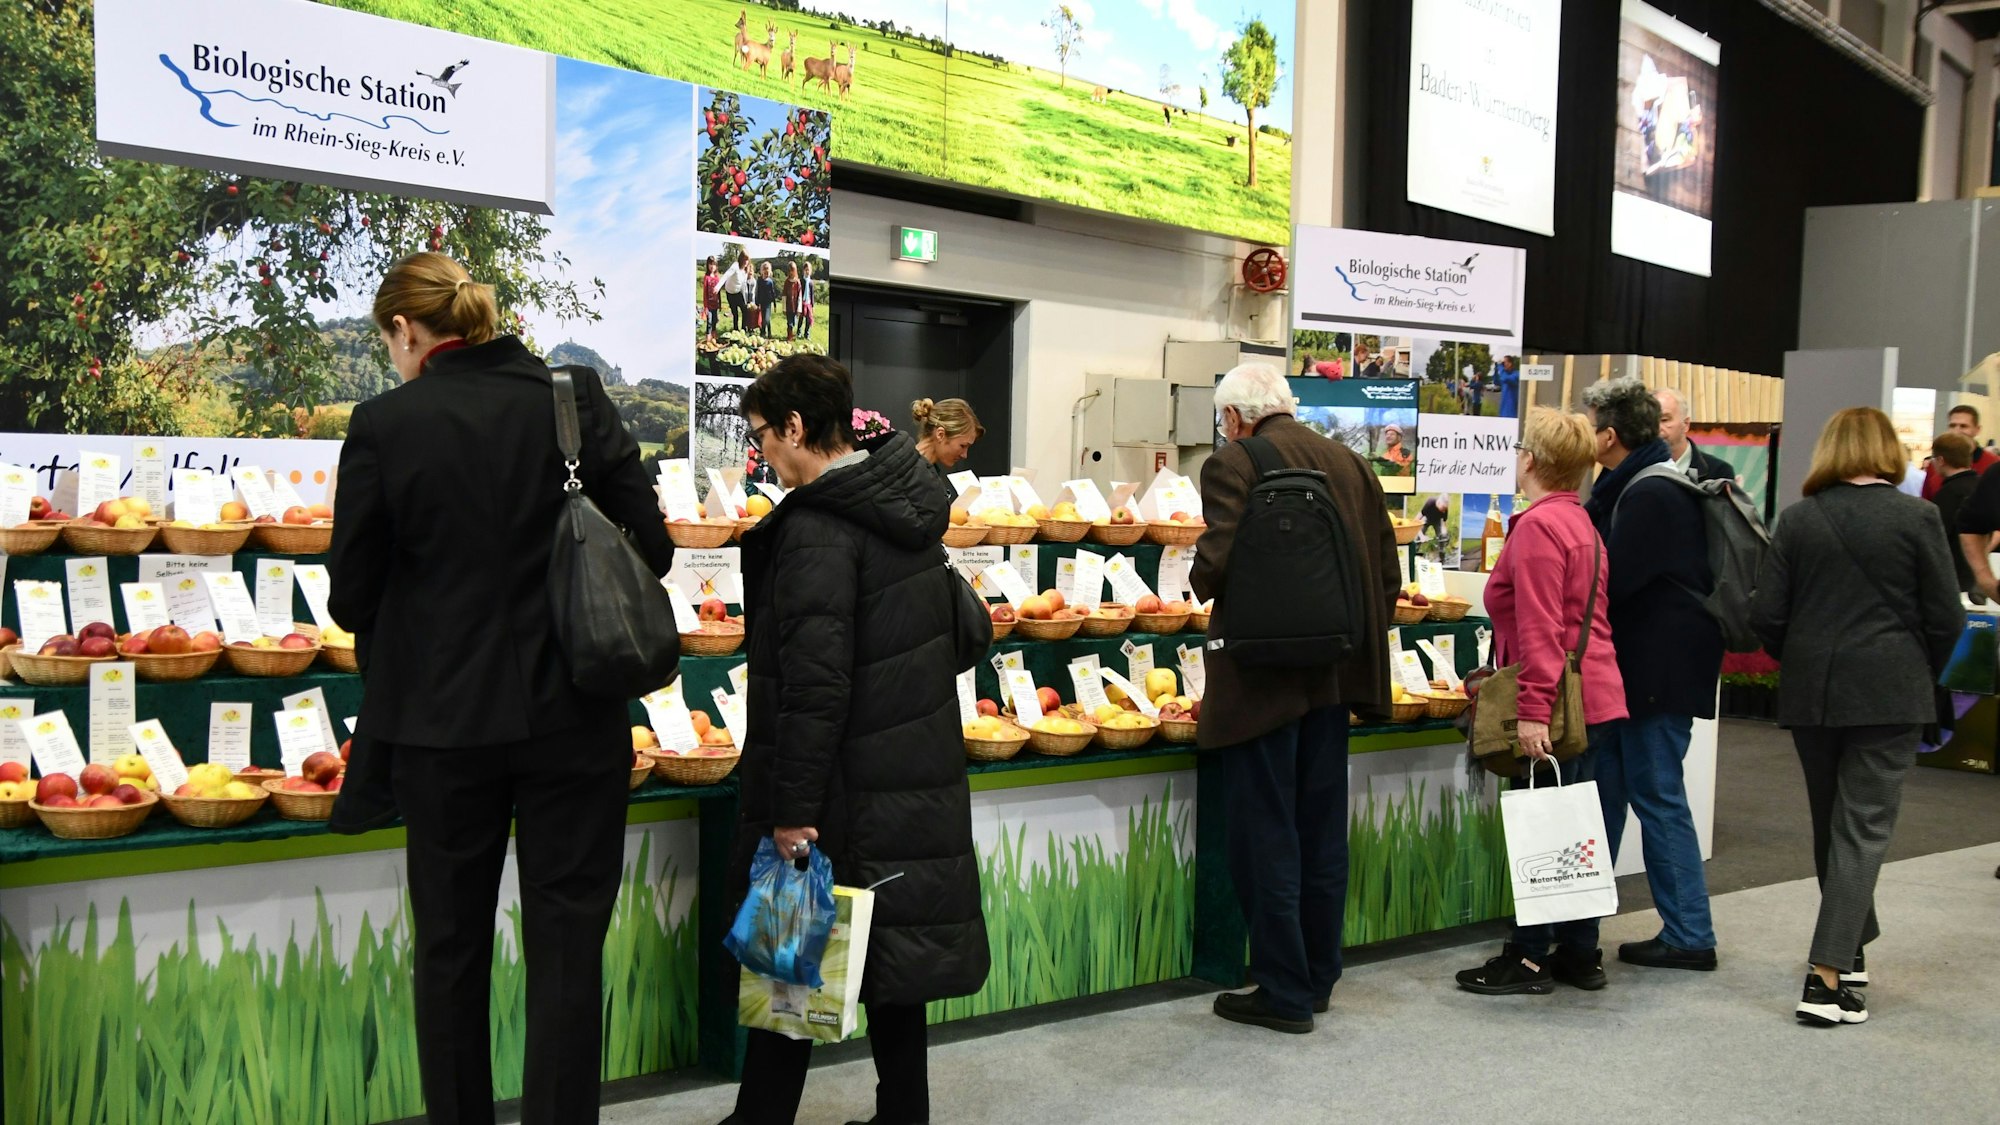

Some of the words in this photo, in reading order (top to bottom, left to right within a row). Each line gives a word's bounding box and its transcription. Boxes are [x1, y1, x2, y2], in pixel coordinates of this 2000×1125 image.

[193, 43, 350, 98] Biologische
[360, 76, 448, 115] Station
[252, 116, 278, 139] im
[284, 122, 431, 166] Rhein-Sieg-Kreis
[436, 143, 466, 168] e.V.
[1349, 258, 1421, 282] Biologische
[1425, 266, 1467, 285] Station
[1374, 294, 1386, 306] im
[1388, 296, 1458, 313] Rhein-Sieg-Kreis
[1460, 303, 1476, 314] e.V.
[1454, 431, 1468, 450] in
[1472, 434, 1513, 452] NRW
[1429, 458, 1447, 477] für
[1448, 459, 1467, 476] die
[1469, 461, 1507, 478] Natur
[1530, 873, 1574, 884] Motorsport
[1576, 870, 1600, 879] Arena
